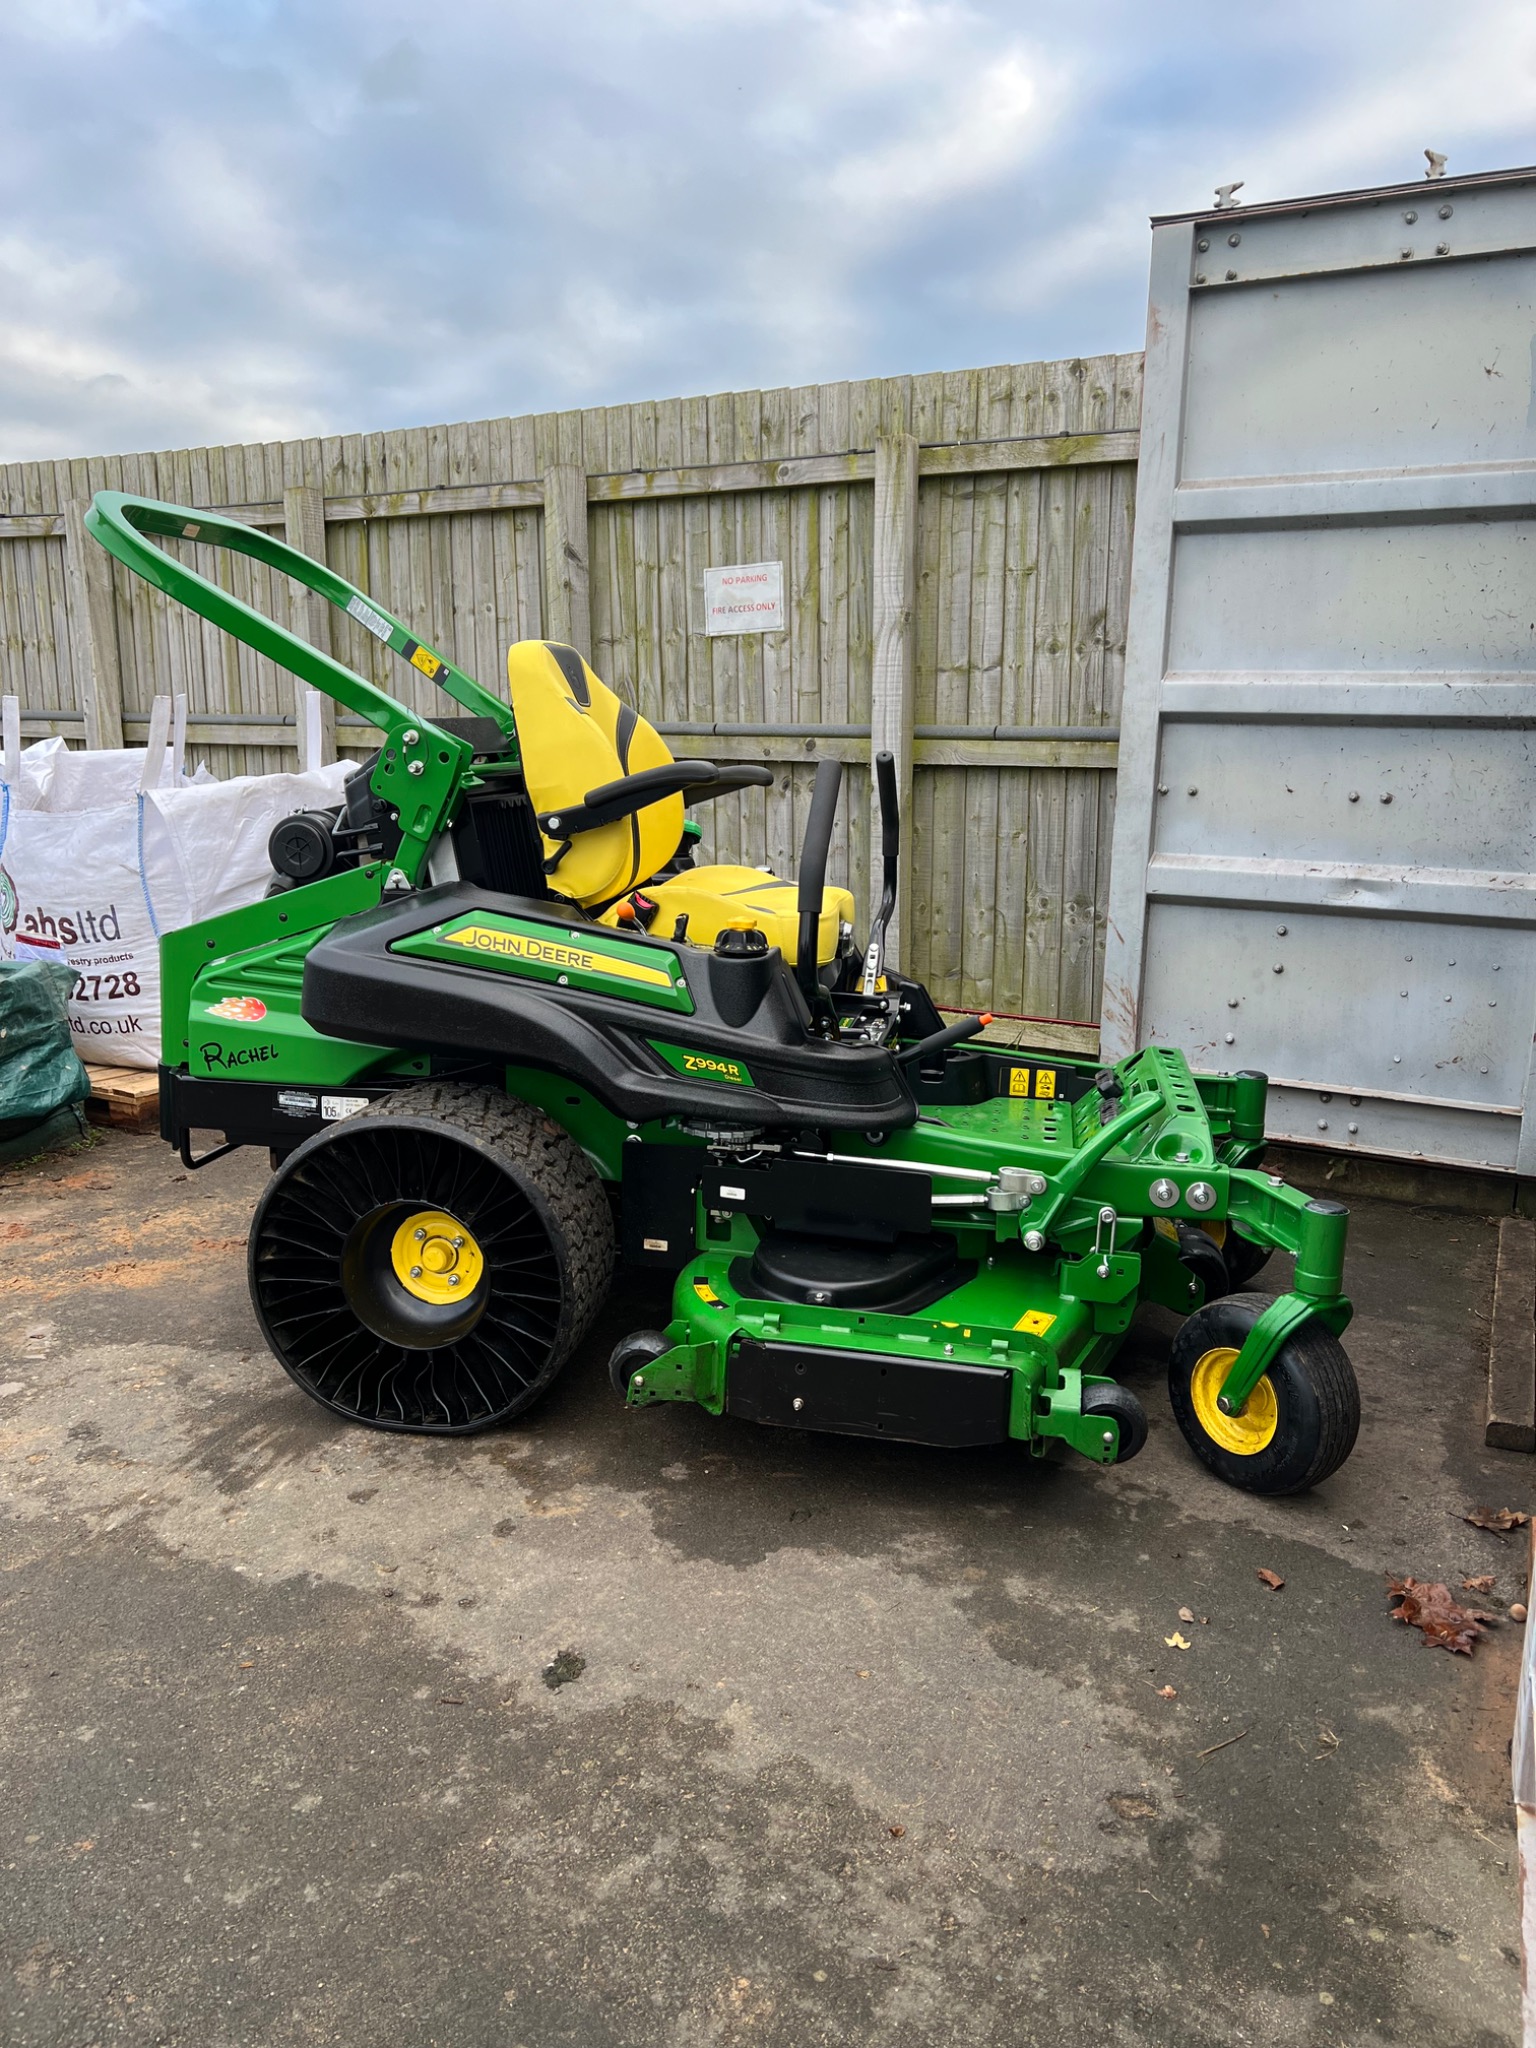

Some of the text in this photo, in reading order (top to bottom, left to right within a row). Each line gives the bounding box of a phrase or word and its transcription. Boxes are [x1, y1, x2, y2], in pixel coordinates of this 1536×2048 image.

[722, 574, 767, 585] NO PARKING
[712, 602, 776, 615] FIRE ACCESS ONLY
[67, 952, 134, 967] restry products
[466, 930, 594, 969] JOHN DEERE
[68, 971, 141, 1001] 2728
[68, 1015, 143, 1035] td.co.uk
[200, 1042, 279, 1072] RACHEL
[683, 1055, 739, 1076] Z994R
[323, 1106, 337, 1117] 105
